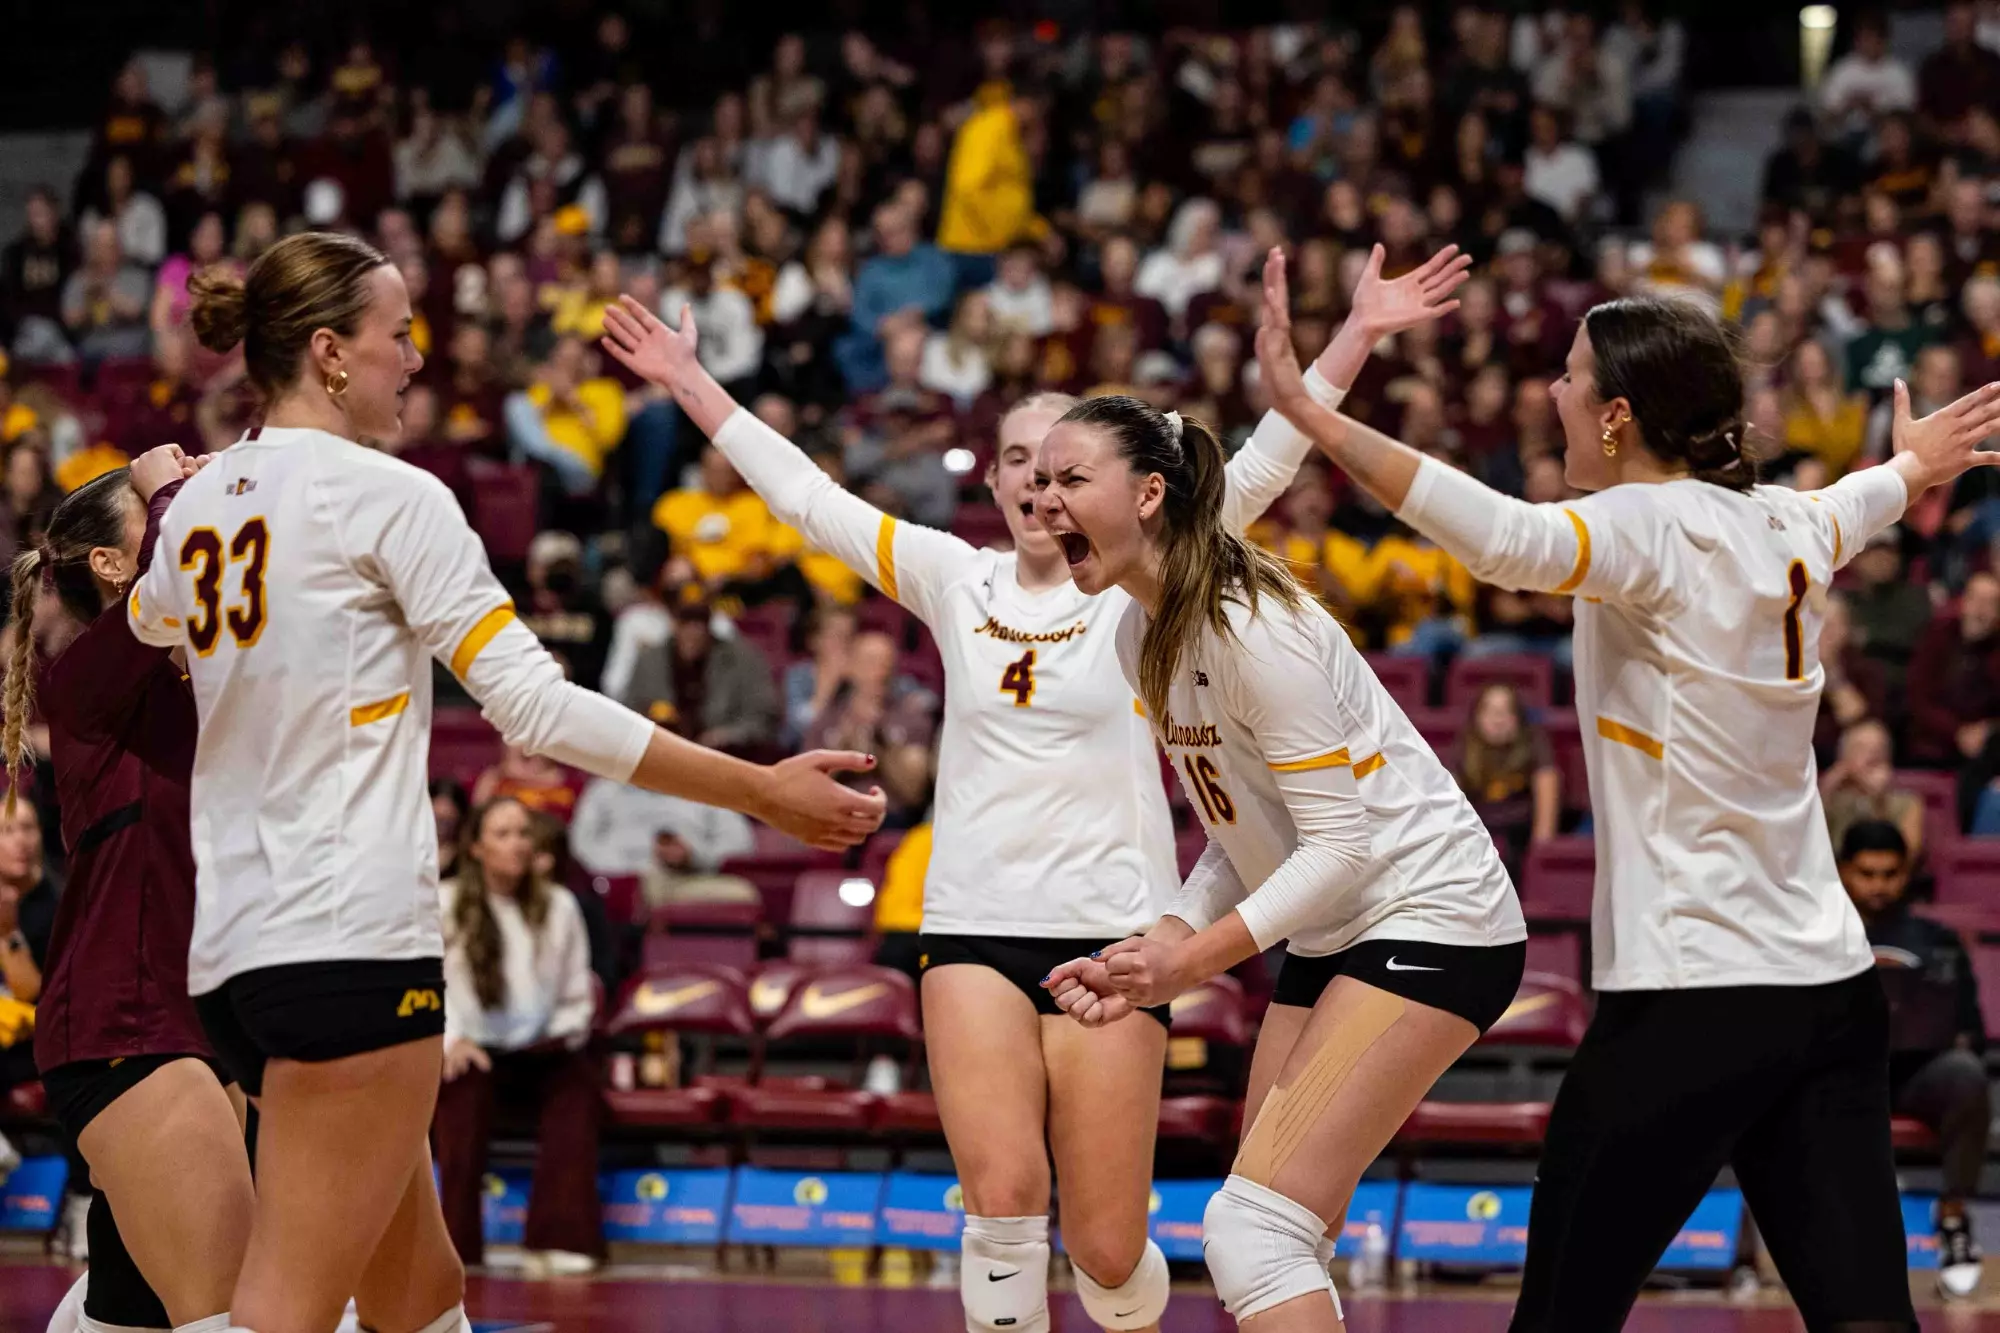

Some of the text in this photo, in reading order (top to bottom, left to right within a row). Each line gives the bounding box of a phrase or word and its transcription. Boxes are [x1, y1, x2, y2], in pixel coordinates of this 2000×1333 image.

[179, 514, 271, 659] 33
[1782, 557, 1810, 682] 1
[998, 648, 1037, 708] 4
[1183, 753, 1237, 826] 16
